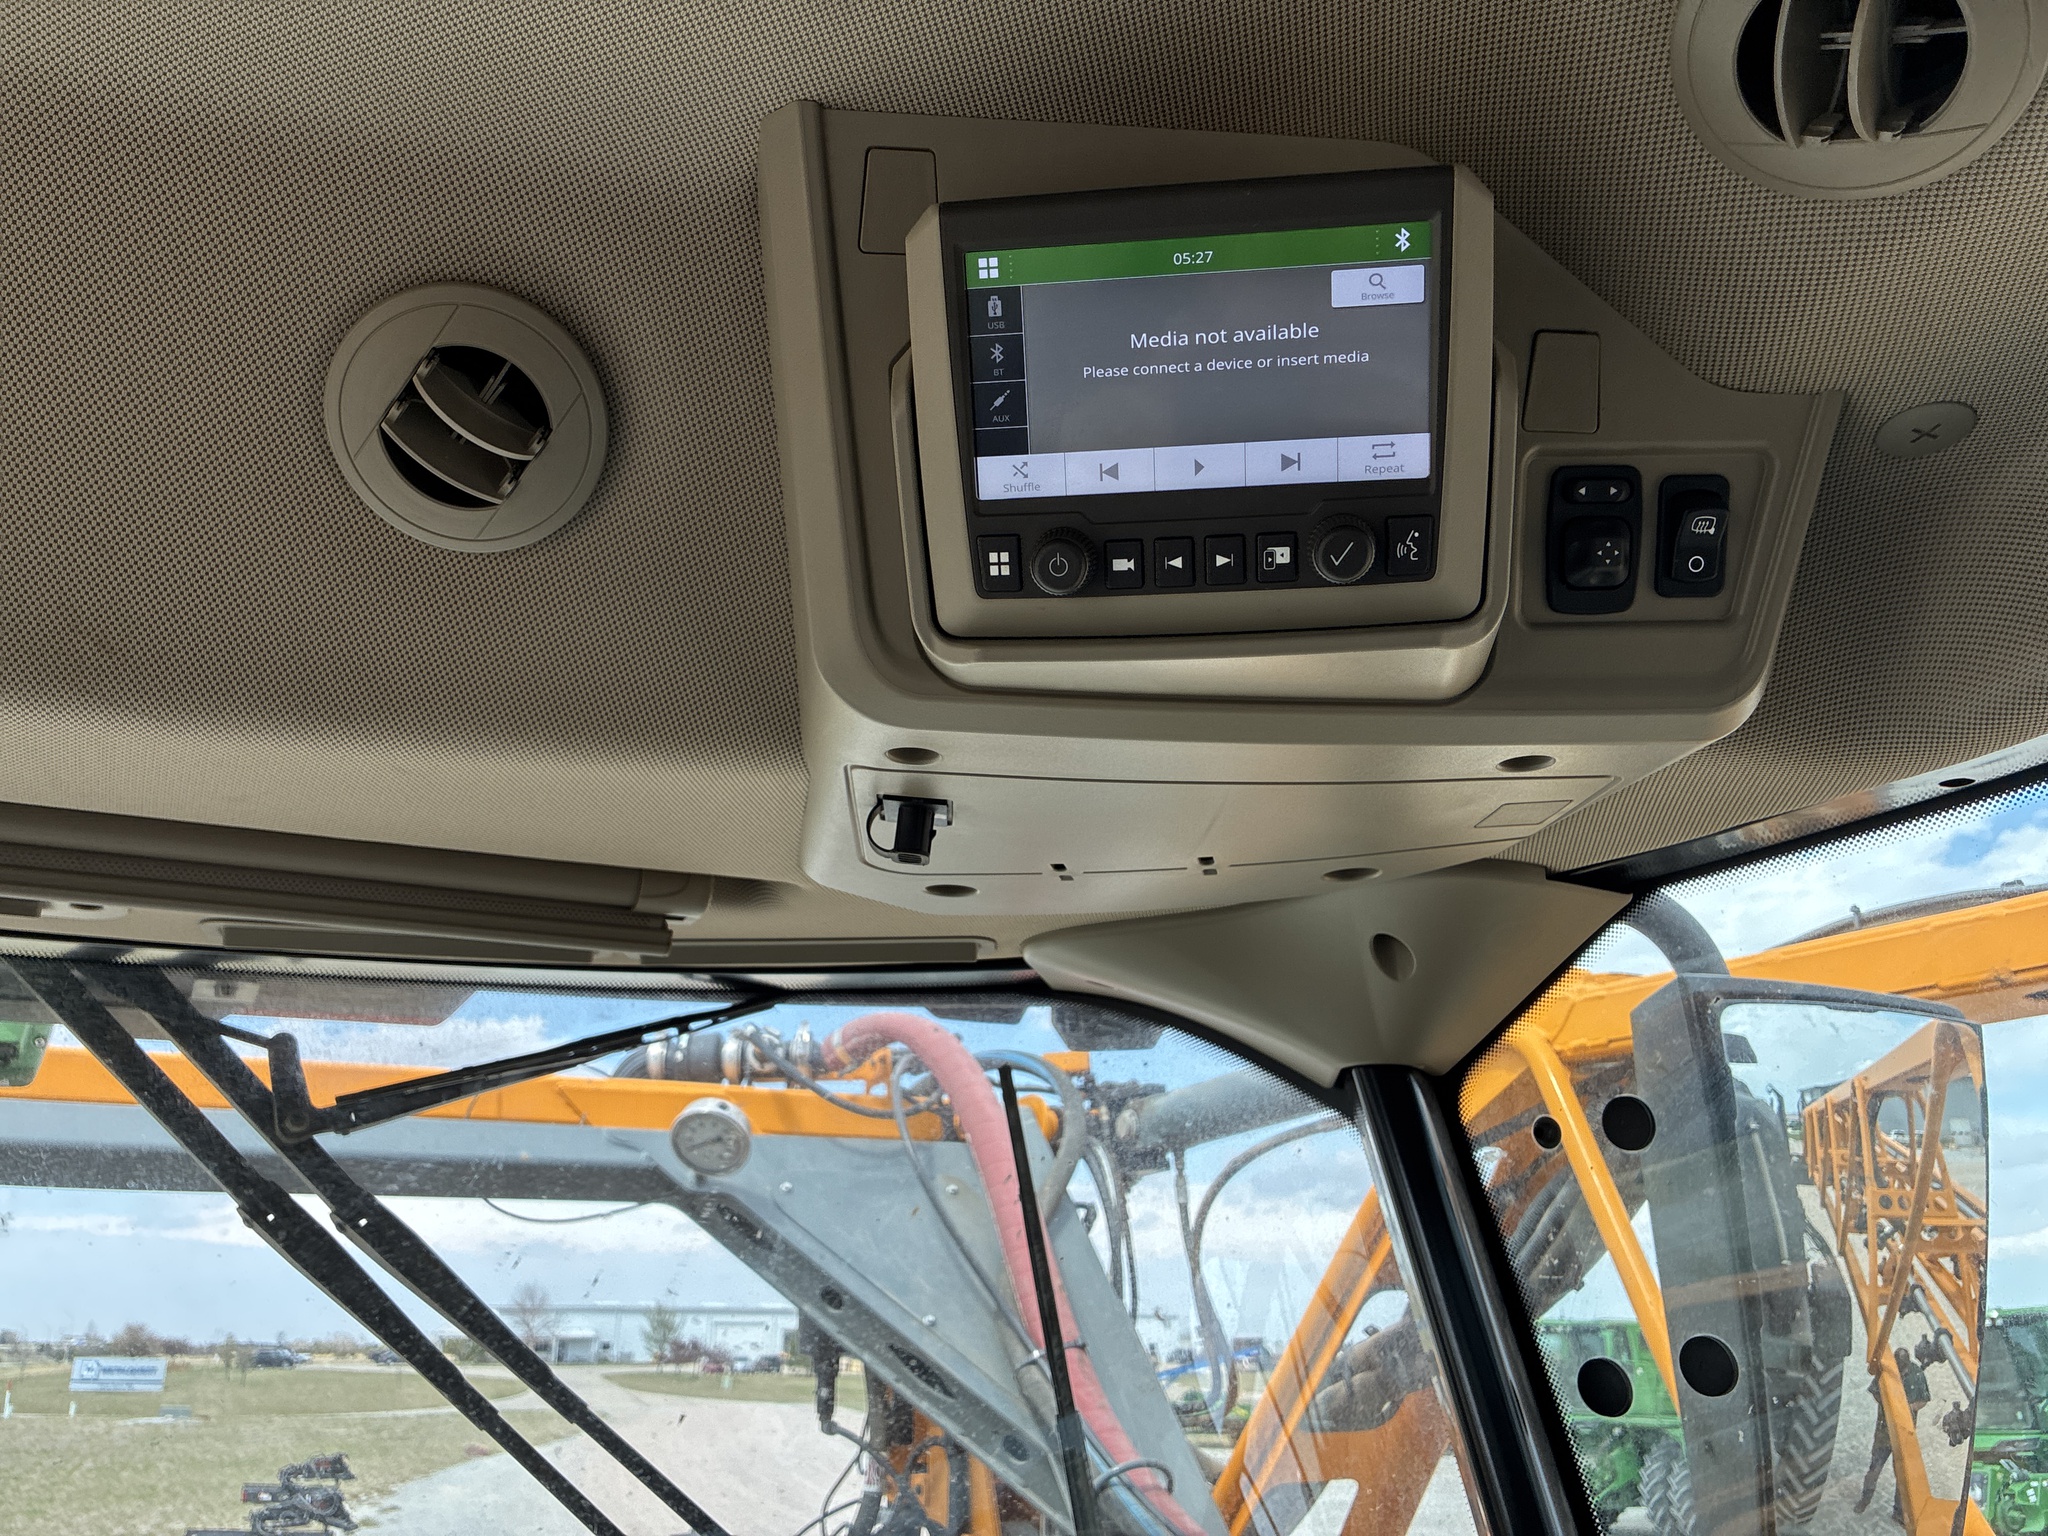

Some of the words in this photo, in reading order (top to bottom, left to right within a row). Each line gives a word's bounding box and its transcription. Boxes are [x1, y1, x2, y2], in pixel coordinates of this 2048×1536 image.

[1173, 250, 1214, 266] 05:27
[1361, 290, 1395, 301] Browse
[987, 321, 1006, 330] USB
[1130, 331, 1189, 349] Media
[1195, 328, 1228, 346] not
[1233, 322, 1320, 343] available
[1083, 365, 1129, 379] Please
[1132, 361, 1191, 376] connect
[1194, 361, 1203, 373] a
[1206, 357, 1253, 372] device
[1257, 356, 1274, 369] or
[1277, 353, 1320, 367] insert
[1323, 350, 1370, 364] media
[993, 368, 1005, 377] BT
[992, 414, 1011, 423] AUX
[1364, 462, 1405, 476] Repeat
[1003, 481, 1041, 493] Shuffle
